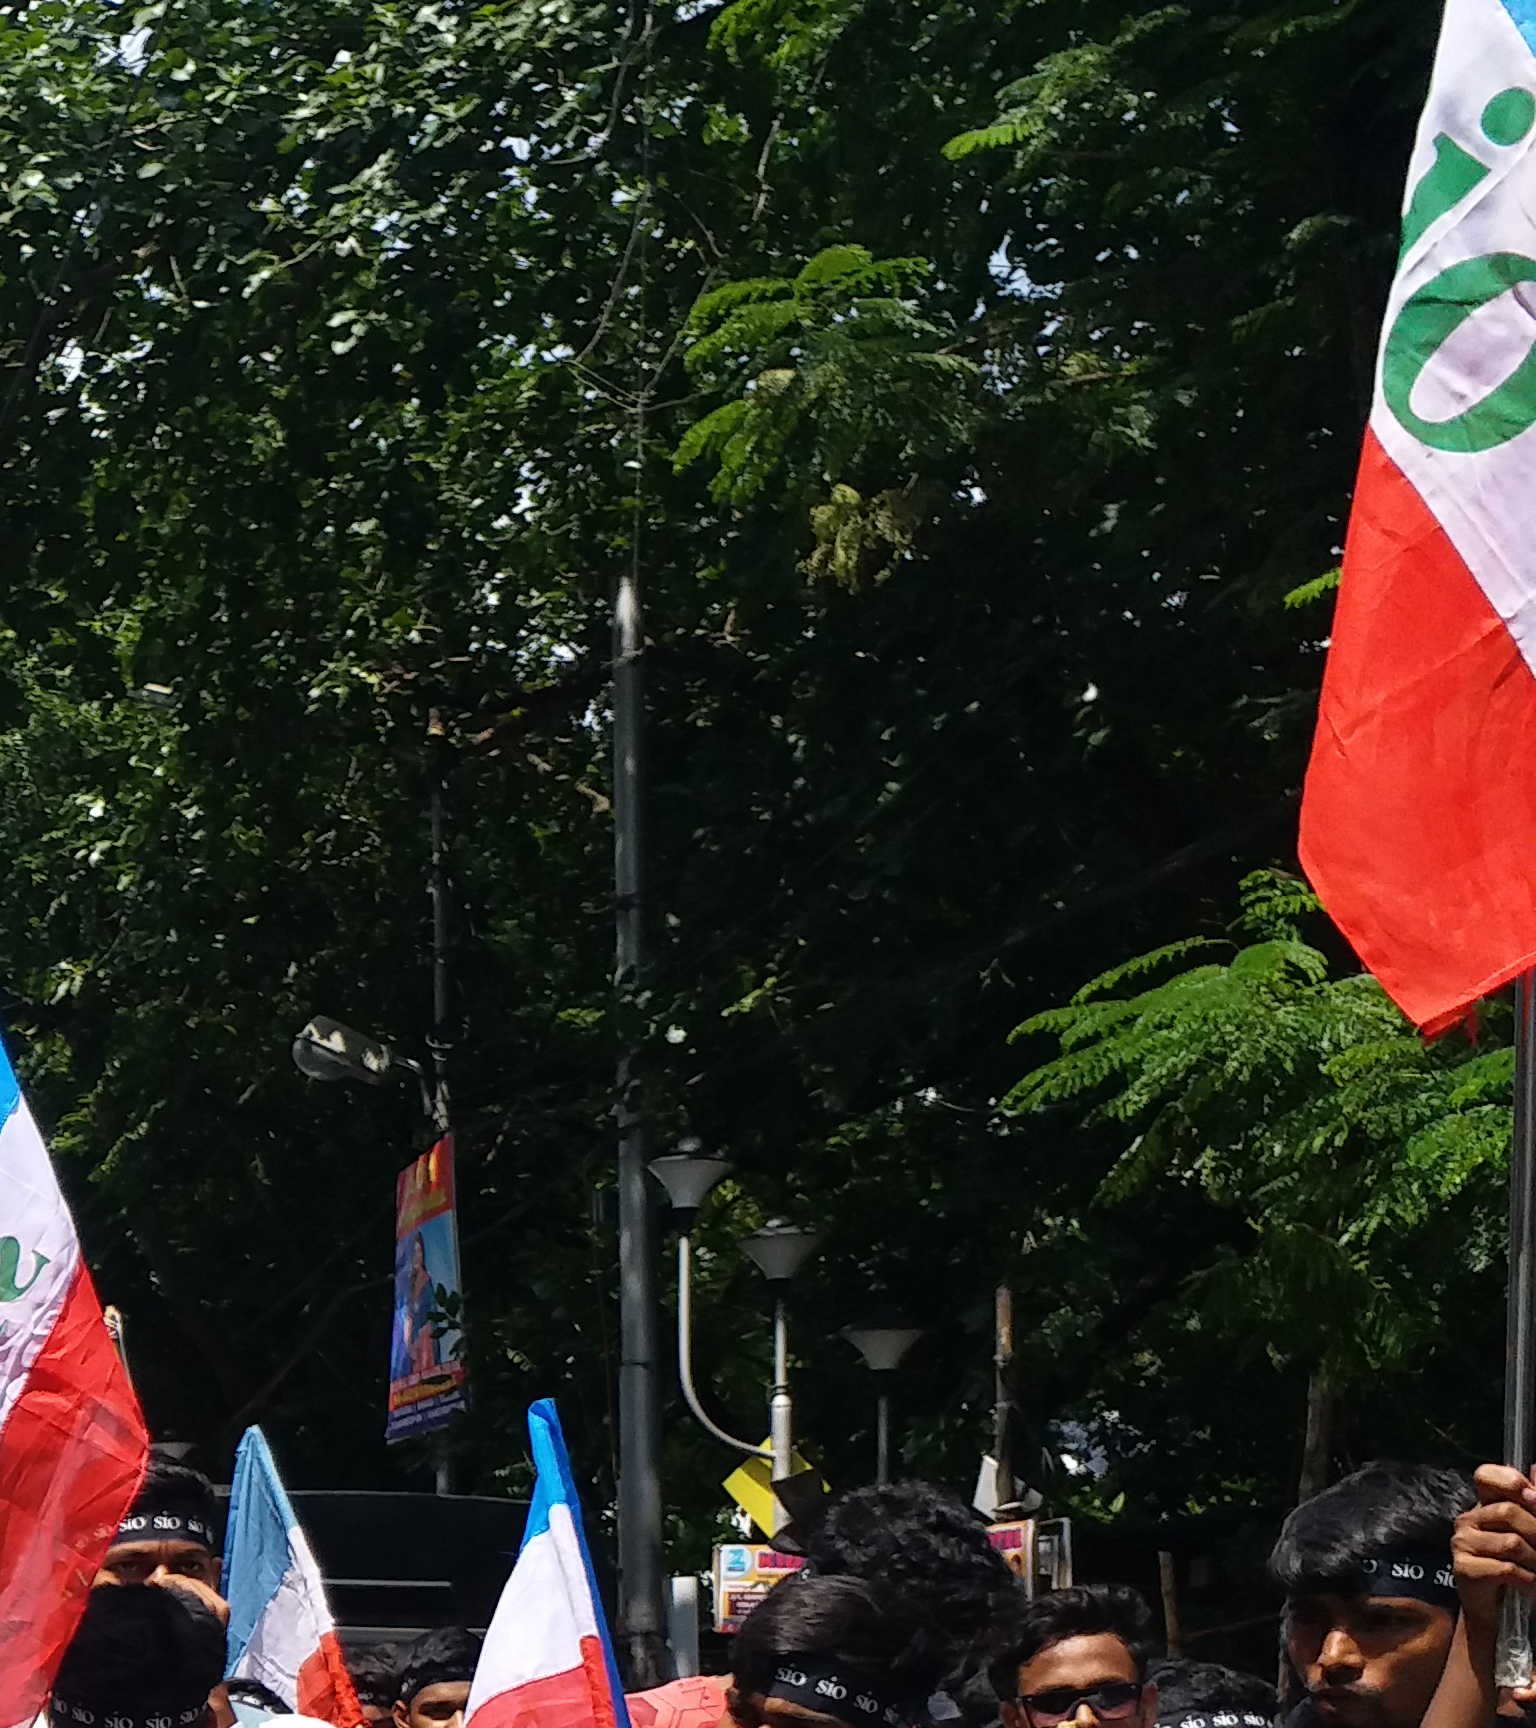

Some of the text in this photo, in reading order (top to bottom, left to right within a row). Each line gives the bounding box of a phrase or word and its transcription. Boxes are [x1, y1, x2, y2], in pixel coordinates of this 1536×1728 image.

[1382, 86, 1536, 454] io
[153, 1510, 181, 1530] sio
[187, 1515, 204, 1534] sio
[1391, 1557, 1425, 1580] sio
[775, 1662, 808, 1687] sio
[815, 1675, 848, 1700] sio
[853, 1690, 879, 1714] sio
[72, 1702, 95, 1725] sio
[180, 1706, 199, 1725] sio
[1212, 1710, 1239, 1728] sio
[1243, 1710, 1266, 1727] sio
